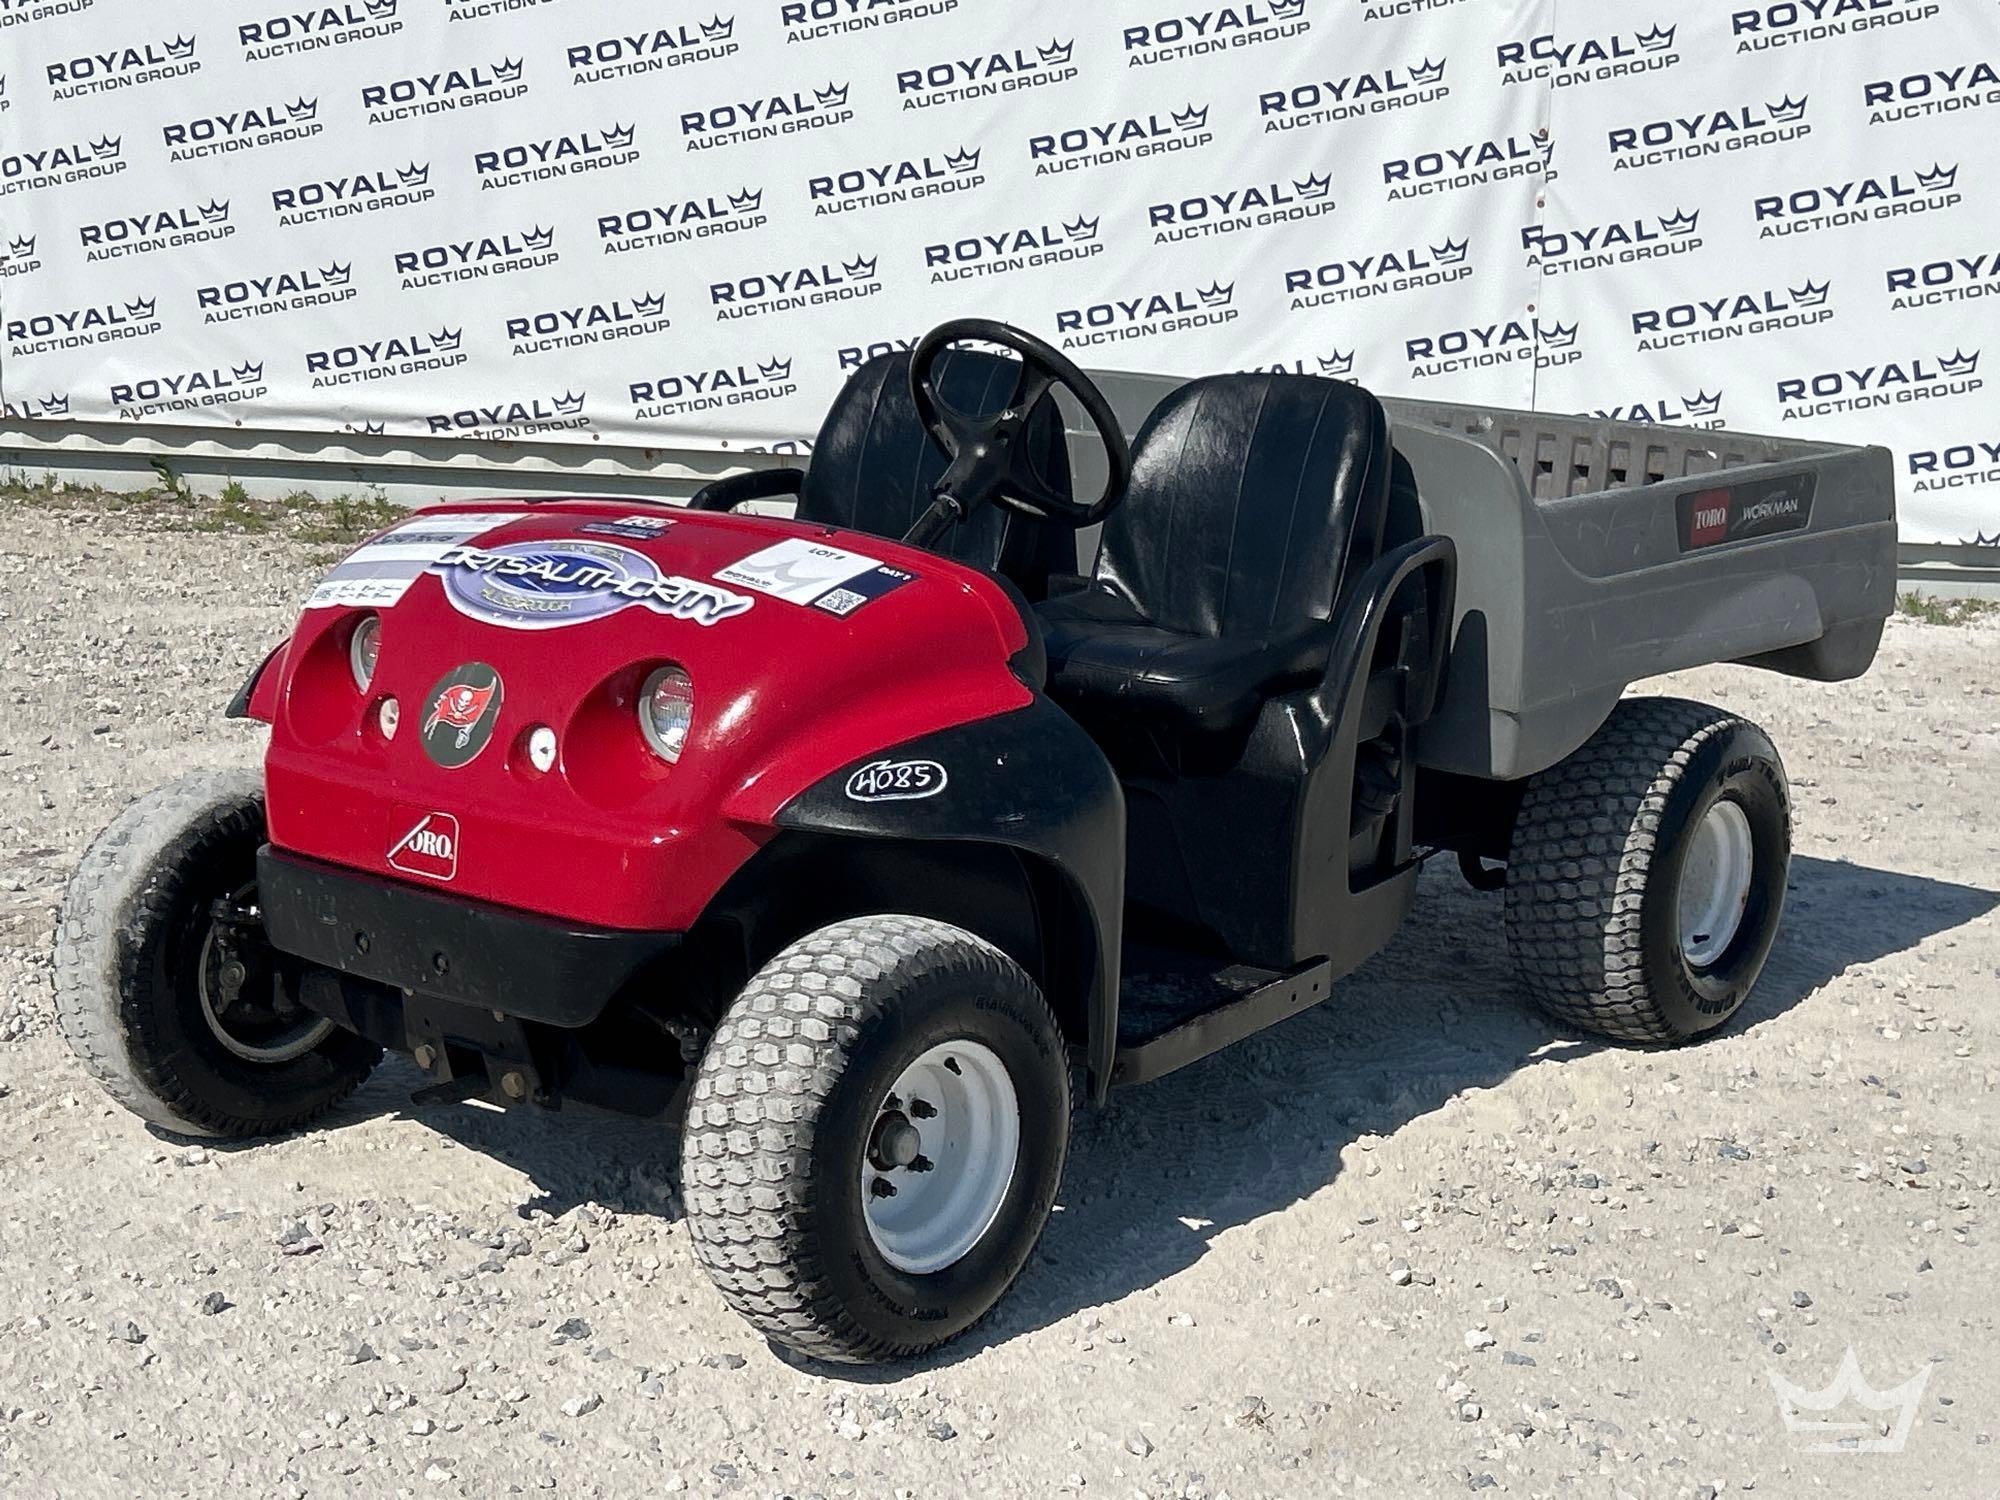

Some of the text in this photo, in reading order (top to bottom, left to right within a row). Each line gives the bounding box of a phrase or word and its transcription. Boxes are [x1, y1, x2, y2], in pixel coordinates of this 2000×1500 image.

[32, 0, 93, 20] GROUP
[239, 5, 366, 46] ROYAL
[787, 0, 958, 44] AUCTION GROUP
[1123, 4, 1268, 50] ROYAL
[1737, 5, 1939, 54] AUCTION GROUP
[246, 22, 403, 62] AUCTION GROUP
[567, 26, 700, 68] ROYAL
[1129, 22, 1310, 68] AUCTION GROUP
[46, 45, 165, 85] ROYAL
[53, 62, 201, 101] AUCTION GROUP
[574, 43, 738, 85] AUCTION GROUP
[897, 50, 1037, 93] ROYAL
[1596, 54, 1679, 80] GROUP
[362, 68, 492, 108] ROYAL
[903, 67, 1078, 111] AUCTION GROUP
[1259, 70, 1408, 116] ROYAL
[1864, 63, 2000, 107] ROYA
[369, 85, 528, 125] AUCTION GROUP
[681, 93, 815, 135] ROYAL
[1265, 87, 1449, 133] AUCTION GROUP
[1869, 94, 1980, 125] AUCTION
[163, 107, 286, 146] ROYAL
[171, 124, 323, 162] AUCTION GROUP
[687, 110, 853, 152] AUCTION GROUP
[1030, 115, 1171, 159] ROYAL
[1609, 107, 1766, 153] ROYAL
[2, 145, 92, 177] OYAL
[475, 133, 602, 174] ROYAL
[1035, 133, 1212, 176] AUCTION GROUP
[1383, 137, 1530, 184] ROYAL
[1614, 125, 1811, 171] AUCTION GROUP
[65, 162, 126, 182] GROUP
[482, 151, 639, 190] AUCTION GROUP
[809, 158, 945, 199] ROYAL
[1388, 171, 1487, 201] AUCTION
[272, 172, 398, 211] ROYAL
[280, 189, 435, 227] AUCTION GROUP
[815, 175, 985, 216] AUCTION GROUP
[1149, 184, 1293, 227] ROYAL
[1755, 175, 1915, 221] ROYAL
[80, 209, 200, 246] ROYAL
[598, 198, 728, 238] ROYAL
[605, 216, 767, 254] AUCTION GROUP
[1154, 201, 1335, 245] AUCTION GROUP
[1760, 194, 1961, 239] AUCTION GROUP
[87, 226, 235, 262] AUCTION GROUP
[395, 235, 523, 274] ROYAL
[925, 226, 1063, 267] ROYAL
[1526, 238, 1702, 275] ACTION GROUP
[0, 261, 41, 277] ROUP
[402, 253, 559, 290] AUCTION GROUP
[931, 244, 1103, 284] AUCTION GROUP
[1285, 249, 1430, 293] ROYAL
[1887, 253, 2000, 292] ROY
[197, 271, 321, 308] ROYAL
[710, 265, 843, 304] ROYAL
[717, 283, 881, 321] AUCTION GROUP
[1291, 267, 1472, 310] AUCTION GROUP
[7, 305, 126, 341] ROYAL
[205, 288, 356, 324] AUCTION GROUP
[506, 302, 633, 339] ROYAL
[1057, 292, 1197, 333] ROYAL
[1632, 291, 1788, 334] ROYAL
[12, 322, 161, 357] AUCTION GROUP
[513, 320, 670, 356] AUCTION GROUP
[1063, 310, 1238, 349] AUCTION GROUP
[1638, 310, 1833, 352] AUCTION GROUP
[306, 336, 431, 373] ROYAL
[312, 354, 467, 389] AUCTION GROUP
[1412, 351, 1512, 379] AUCTION
[111, 369, 232, 405] ROYAL
[629, 366, 759, 403] ROYAL
[1777, 360, 1937, 403] ROYAL
[1782, 379, 1982, 421] AUCTION GROUP
[119, 386, 268, 420] AUCTION GROUP
[426, 400, 552, 434] ROYAL
[635, 384, 797, 420] AUCTION GROUP
[524, 417, 591, 435] GROUP
[1909, 443, 2000, 474] ROY
[1914, 469, 2000, 493] AUCTIO
[1695, 508, 1727, 530] TORO
[1743, 499, 1798, 520] WORKMAN
